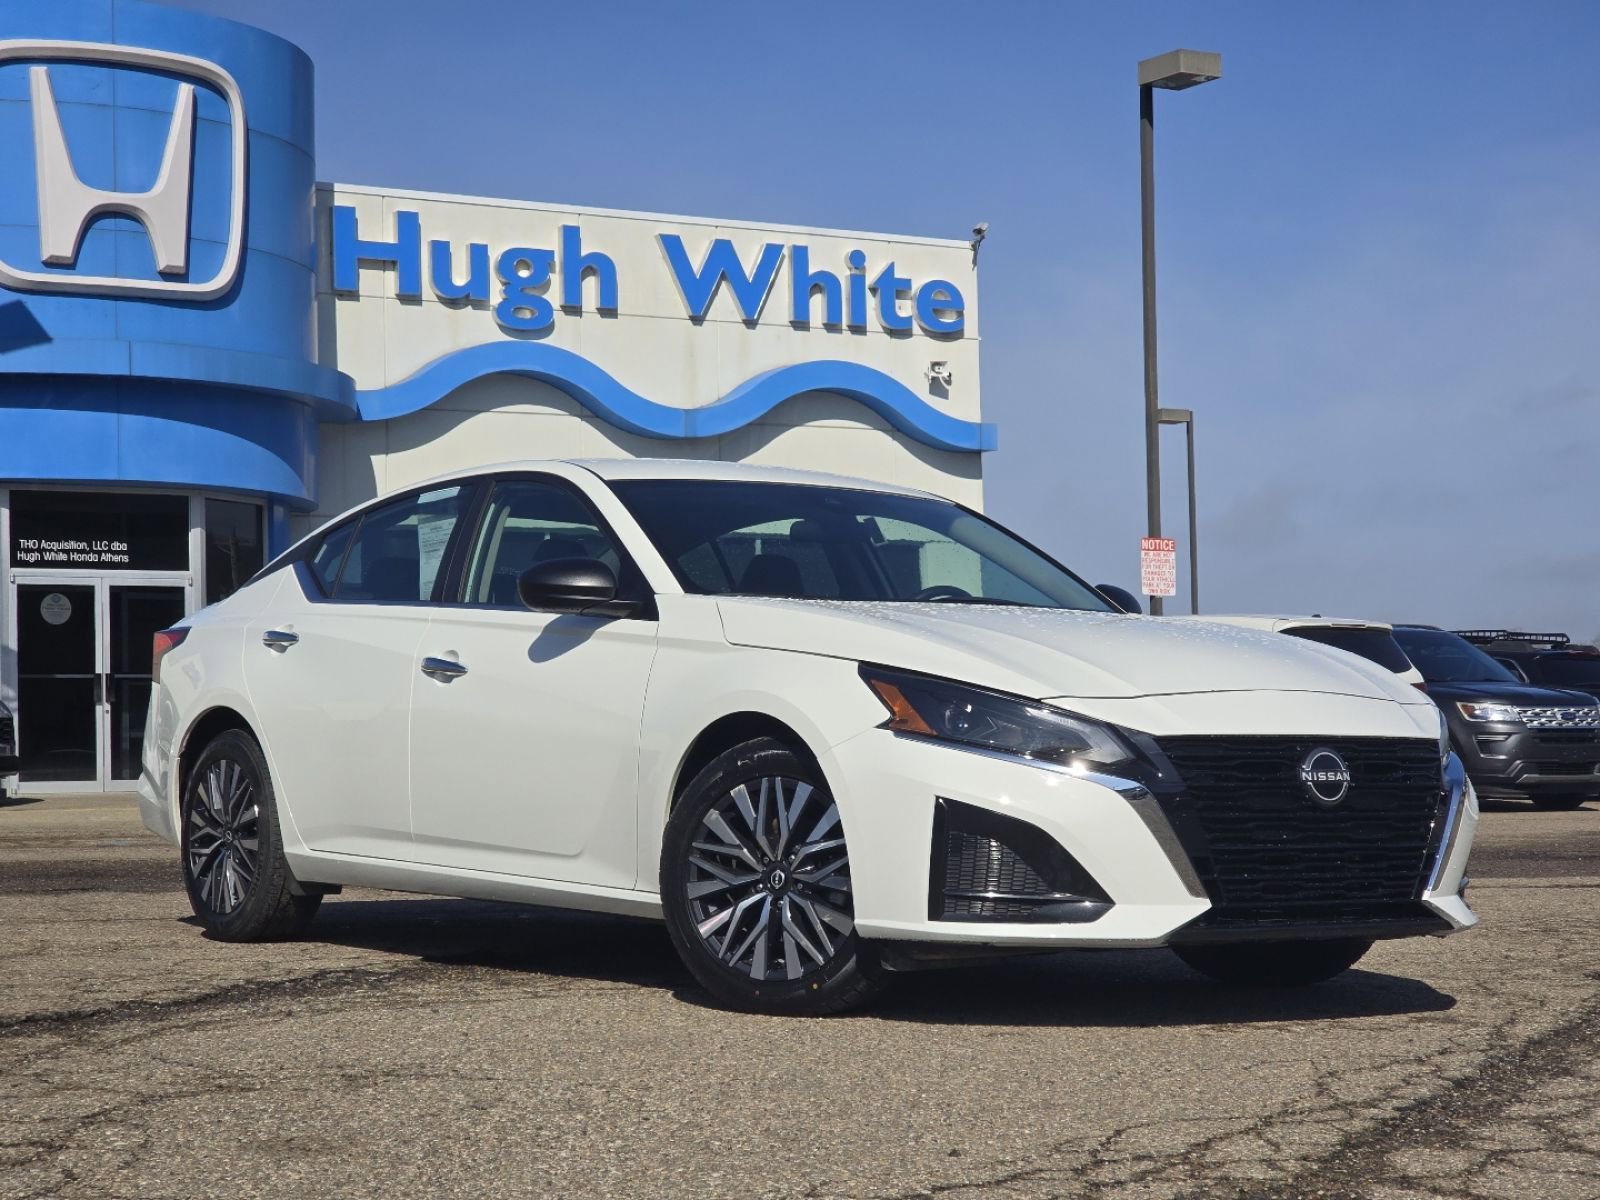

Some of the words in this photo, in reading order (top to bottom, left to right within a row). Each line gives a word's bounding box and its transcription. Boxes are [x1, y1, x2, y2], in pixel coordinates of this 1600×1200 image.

[330, 205, 618, 332] Hugh
[657, 231, 966, 338] White
[19, 539, 39, 550] THO
[40, 539, 90, 552] Acquisition,
[92, 540, 109, 551] LLC
[110, 541, 128, 551] dba
[1141, 539, 1175, 551] NOTICE
[17, 550, 41, 563] Hugh
[43, 551, 68, 561] White
[69, 552, 99, 562] Honda
[100, 552, 130, 563] Athens
[1301, 771, 1351, 781] NISSAN
